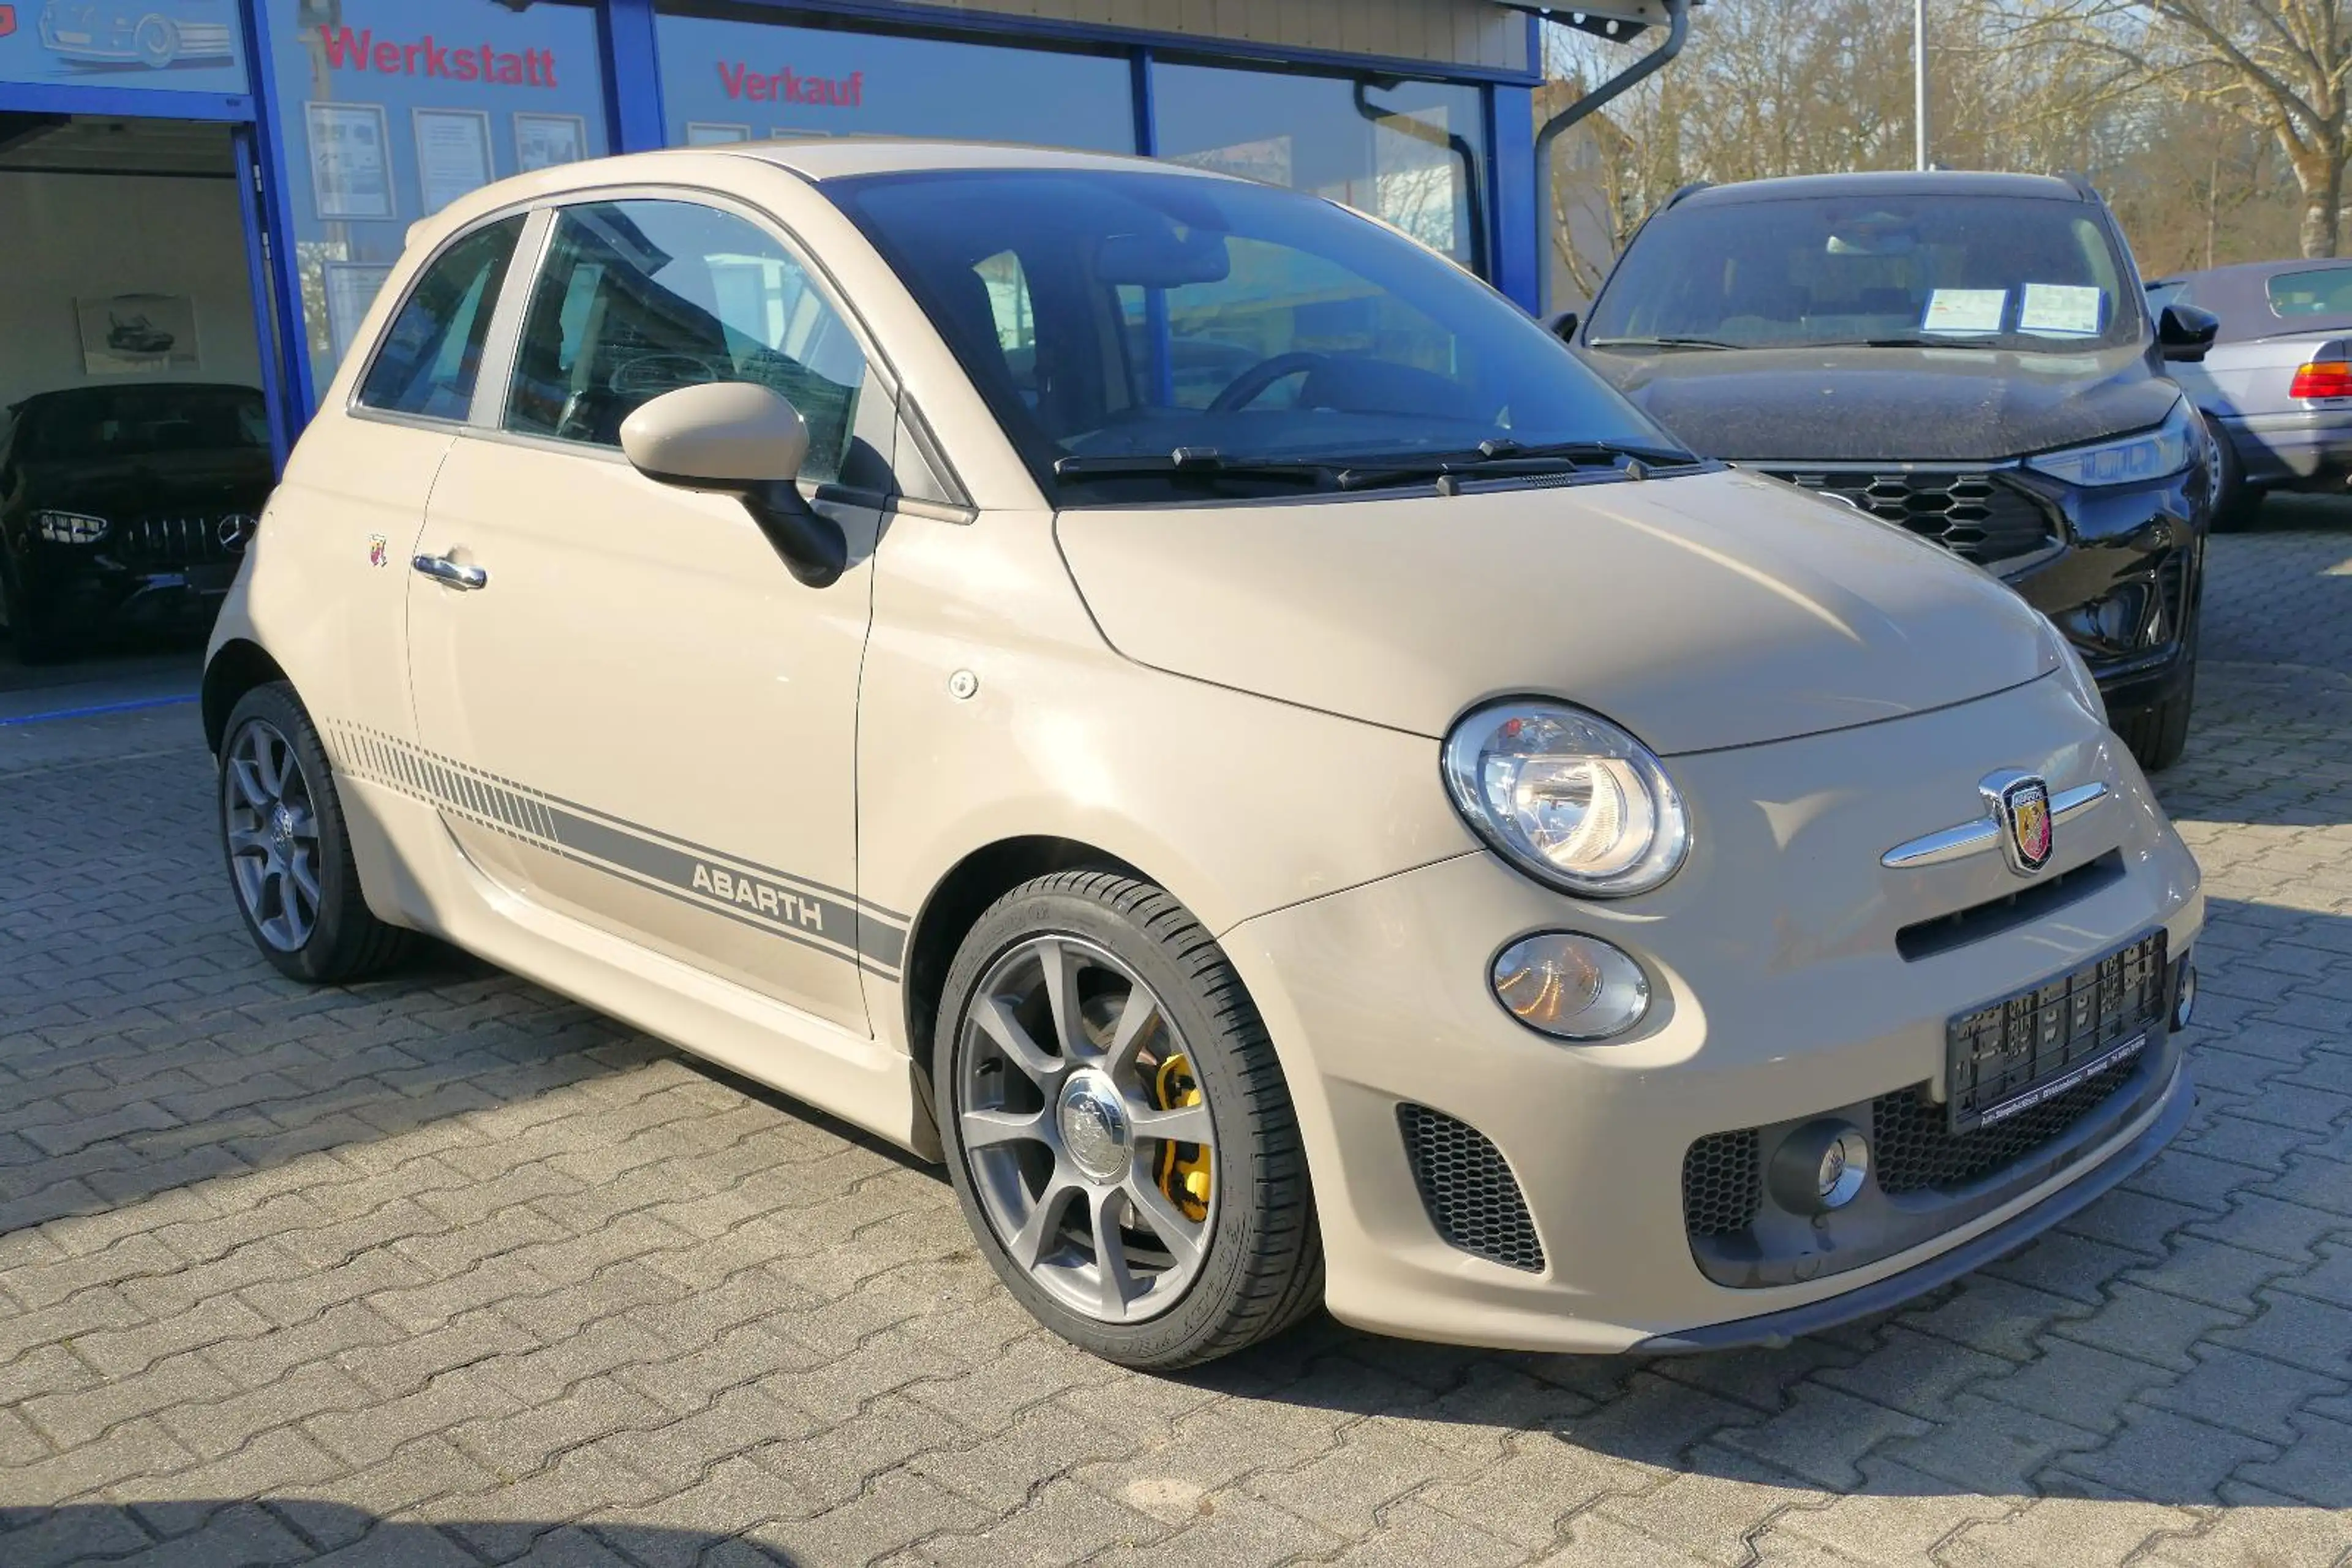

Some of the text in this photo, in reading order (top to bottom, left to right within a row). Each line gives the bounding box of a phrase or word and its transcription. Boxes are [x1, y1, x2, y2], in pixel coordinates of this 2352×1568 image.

[320, 24, 557, 87] Werkstatt
[718, 61, 864, 107] Verkauf
[693, 864, 823, 930] ABARTH
